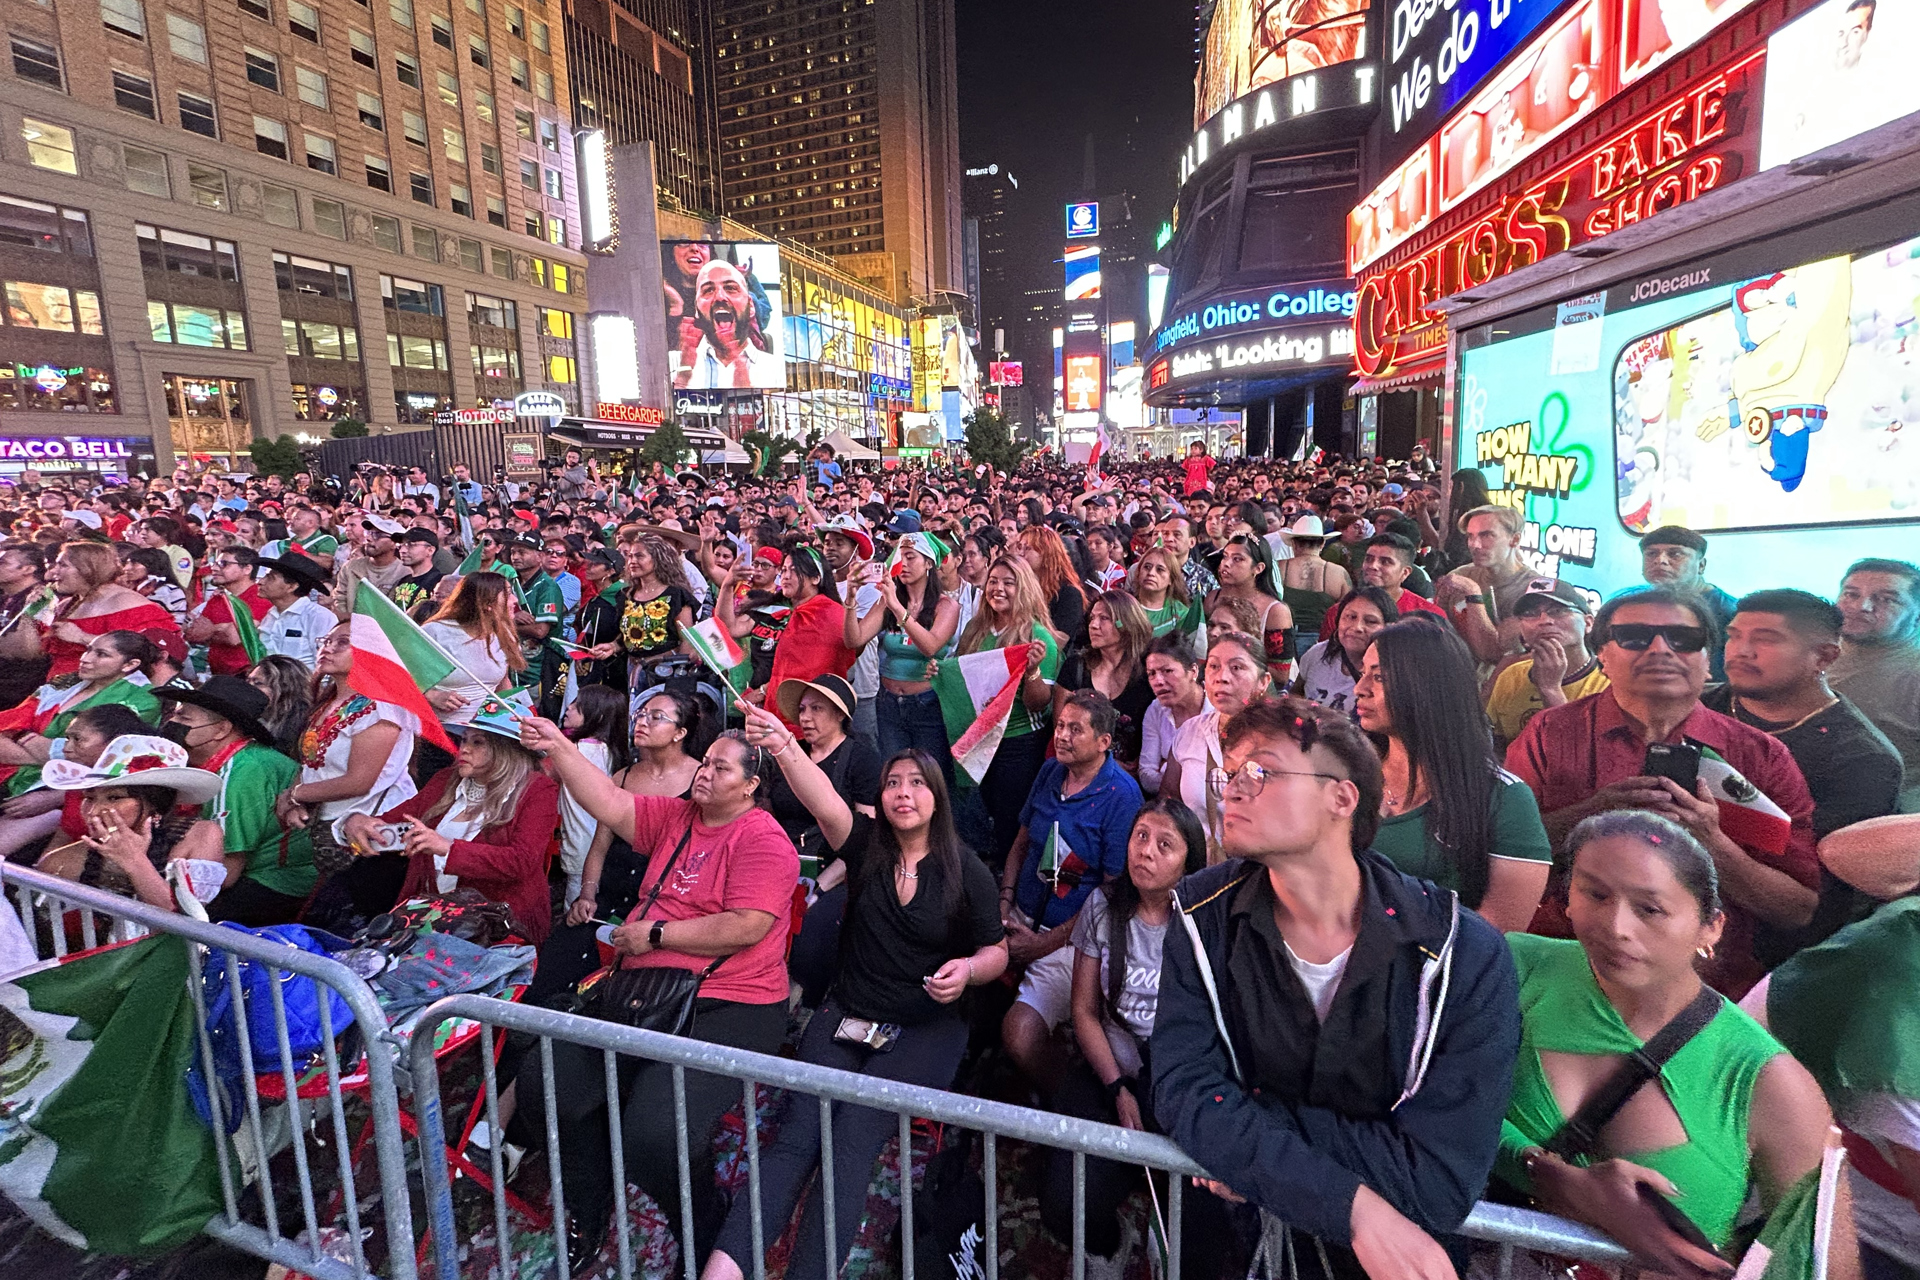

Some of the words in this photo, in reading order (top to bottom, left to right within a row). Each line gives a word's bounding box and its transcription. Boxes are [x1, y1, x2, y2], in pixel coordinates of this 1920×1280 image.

[1391, 55, 1432, 134] We
[1437, 8, 1479, 85] do
[1590, 78, 1727, 200] BAKE
[966, 168, 988, 176] Allianz
[1584, 152, 1724, 238] SHOP
[1630, 268, 1711, 302] JCDecaux
[1157, 312, 1200, 352] Springfield,
[1202, 302, 1260, 330] Ohio:
[1267, 289, 1356, 318] Colleg
[1413, 325, 1449, 350] TIMES
[454, 409, 515, 423] HOTDOGS
[0, 441, 66, 457] TACO
[71, 441, 132, 457] BELL
[1476, 421, 1531, 464] HOW
[27, 459, 83, 470] cantina
[1503, 453, 1577, 493] MANY
[1545, 523, 1597, 560] ONE
[752, 624, 782, 641] MEXI
